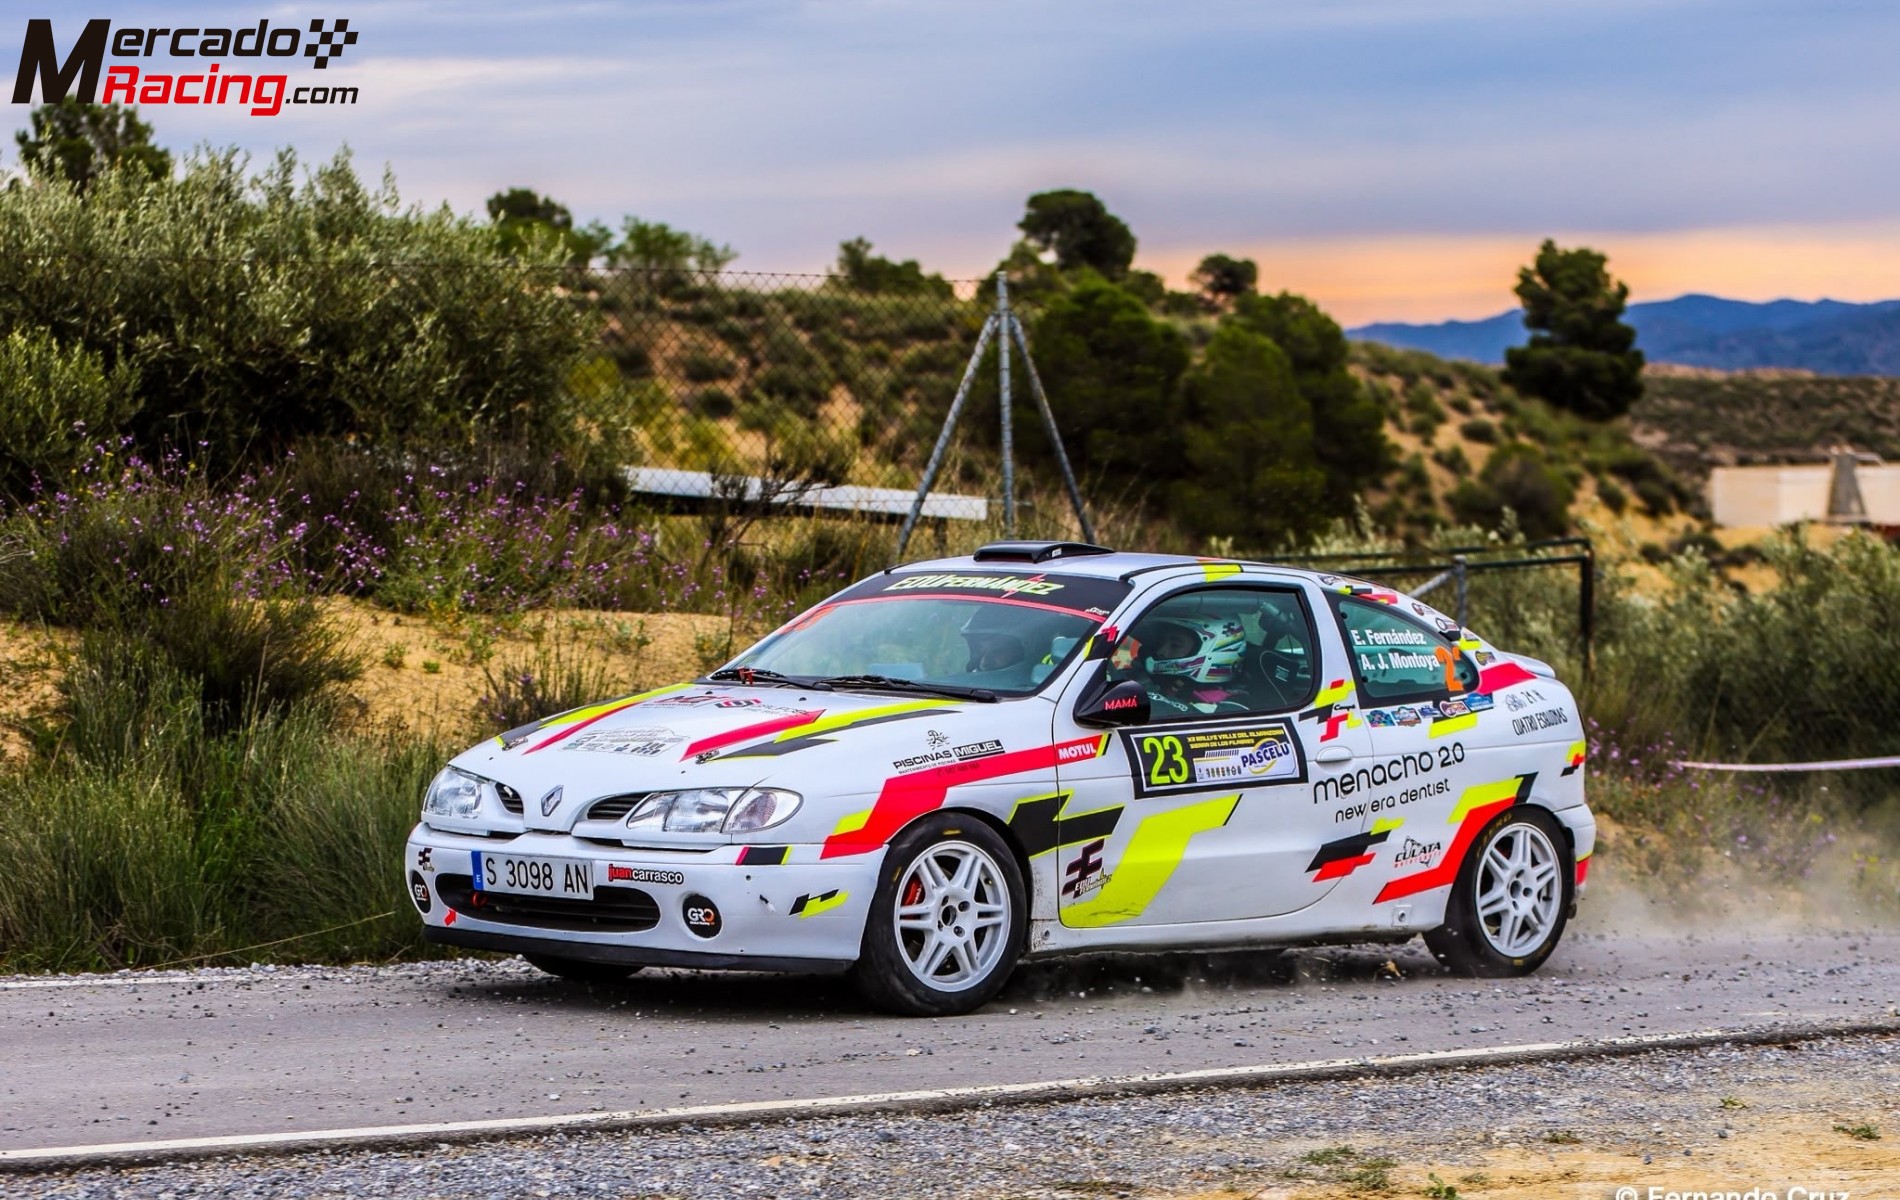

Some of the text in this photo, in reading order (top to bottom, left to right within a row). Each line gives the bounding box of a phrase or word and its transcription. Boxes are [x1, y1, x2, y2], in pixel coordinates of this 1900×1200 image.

[1350, 628, 1427, 646] E. Fernández
[1361, 651, 1440, 672] A. J. Montoya
[1104, 695, 1138, 711] MAMÁ
[1512, 714, 1539, 736] CUATRO
[892, 749, 953, 770] PISCINAS
[954, 741, 1003, 758] MIGUEL
[1057, 742, 1098, 760] MOTUL
[1143, 735, 1189, 785] 23
[1241, 742, 1291, 768] PASCELU
[1313, 741, 1465, 804] menacho 2.0
[1335, 778, 1450, 823] new era dentist
[1394, 841, 1442, 863] CULATA
[485, 857, 589, 894] S 3098 AN
